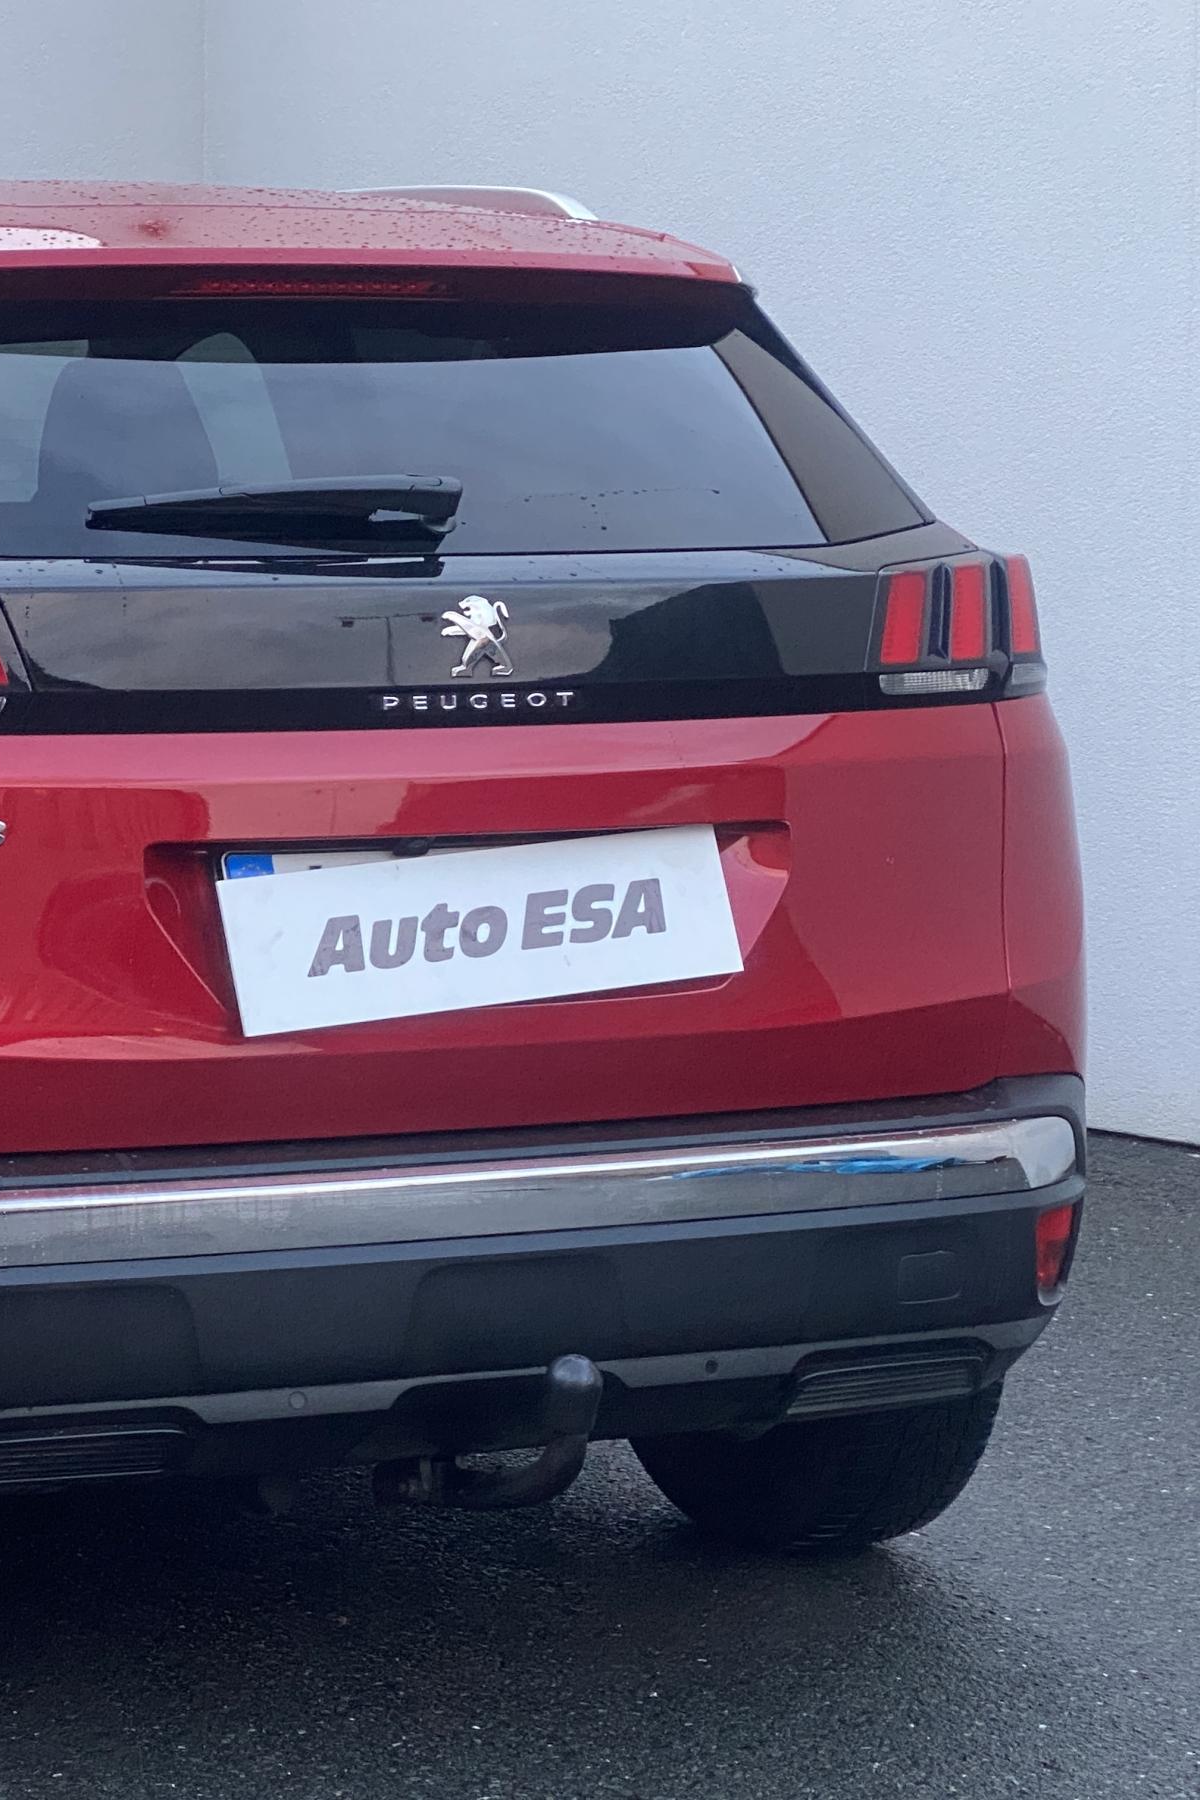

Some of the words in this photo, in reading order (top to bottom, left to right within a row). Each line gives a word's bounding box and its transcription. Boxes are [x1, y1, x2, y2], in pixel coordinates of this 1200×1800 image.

[383, 691, 574, 711] PEUGEOT
[306, 902, 509, 979] Auto
[520, 877, 668, 951] ESA
